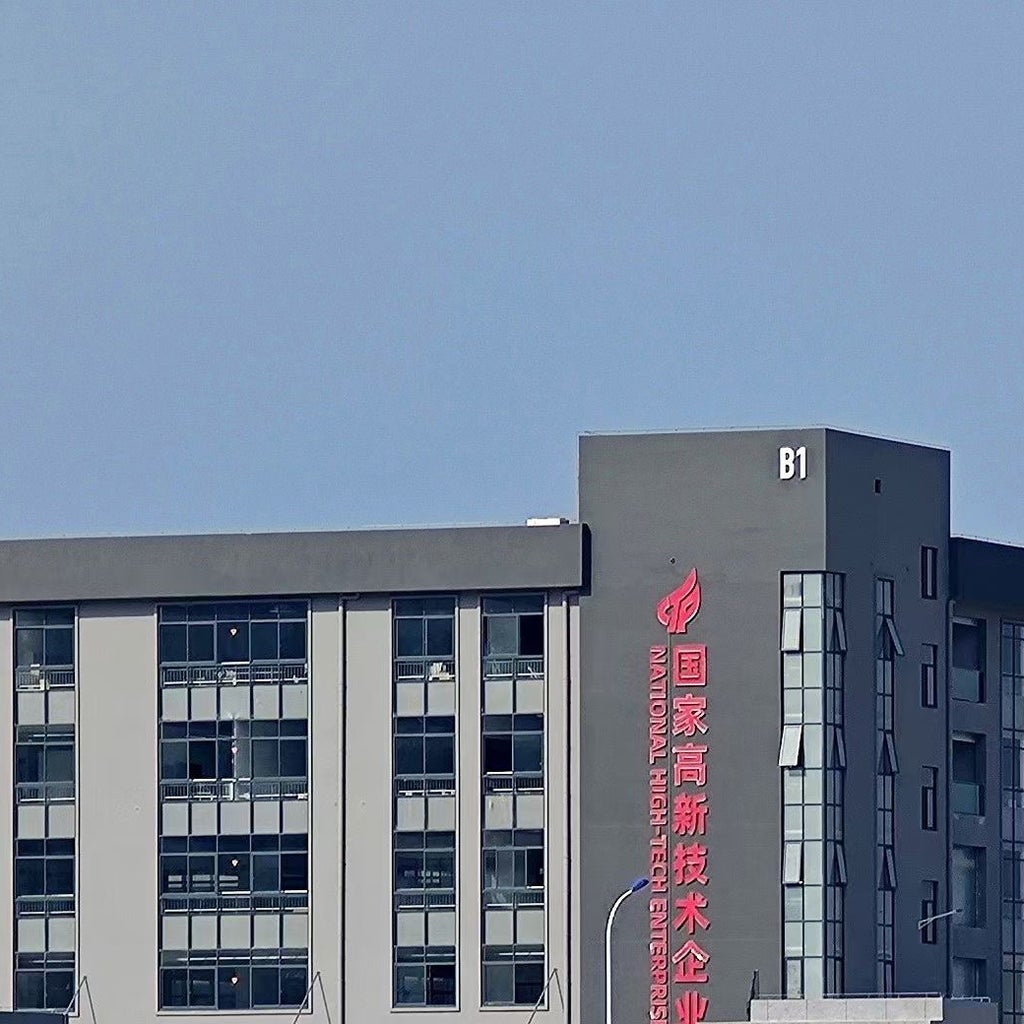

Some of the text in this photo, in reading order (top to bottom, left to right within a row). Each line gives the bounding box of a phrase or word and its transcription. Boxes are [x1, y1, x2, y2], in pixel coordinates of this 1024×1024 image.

[779, 446, 807, 480] B1
[649, 647, 668, 765] NATIONAL
[649, 769, 668, 892] HIGH-TECH
